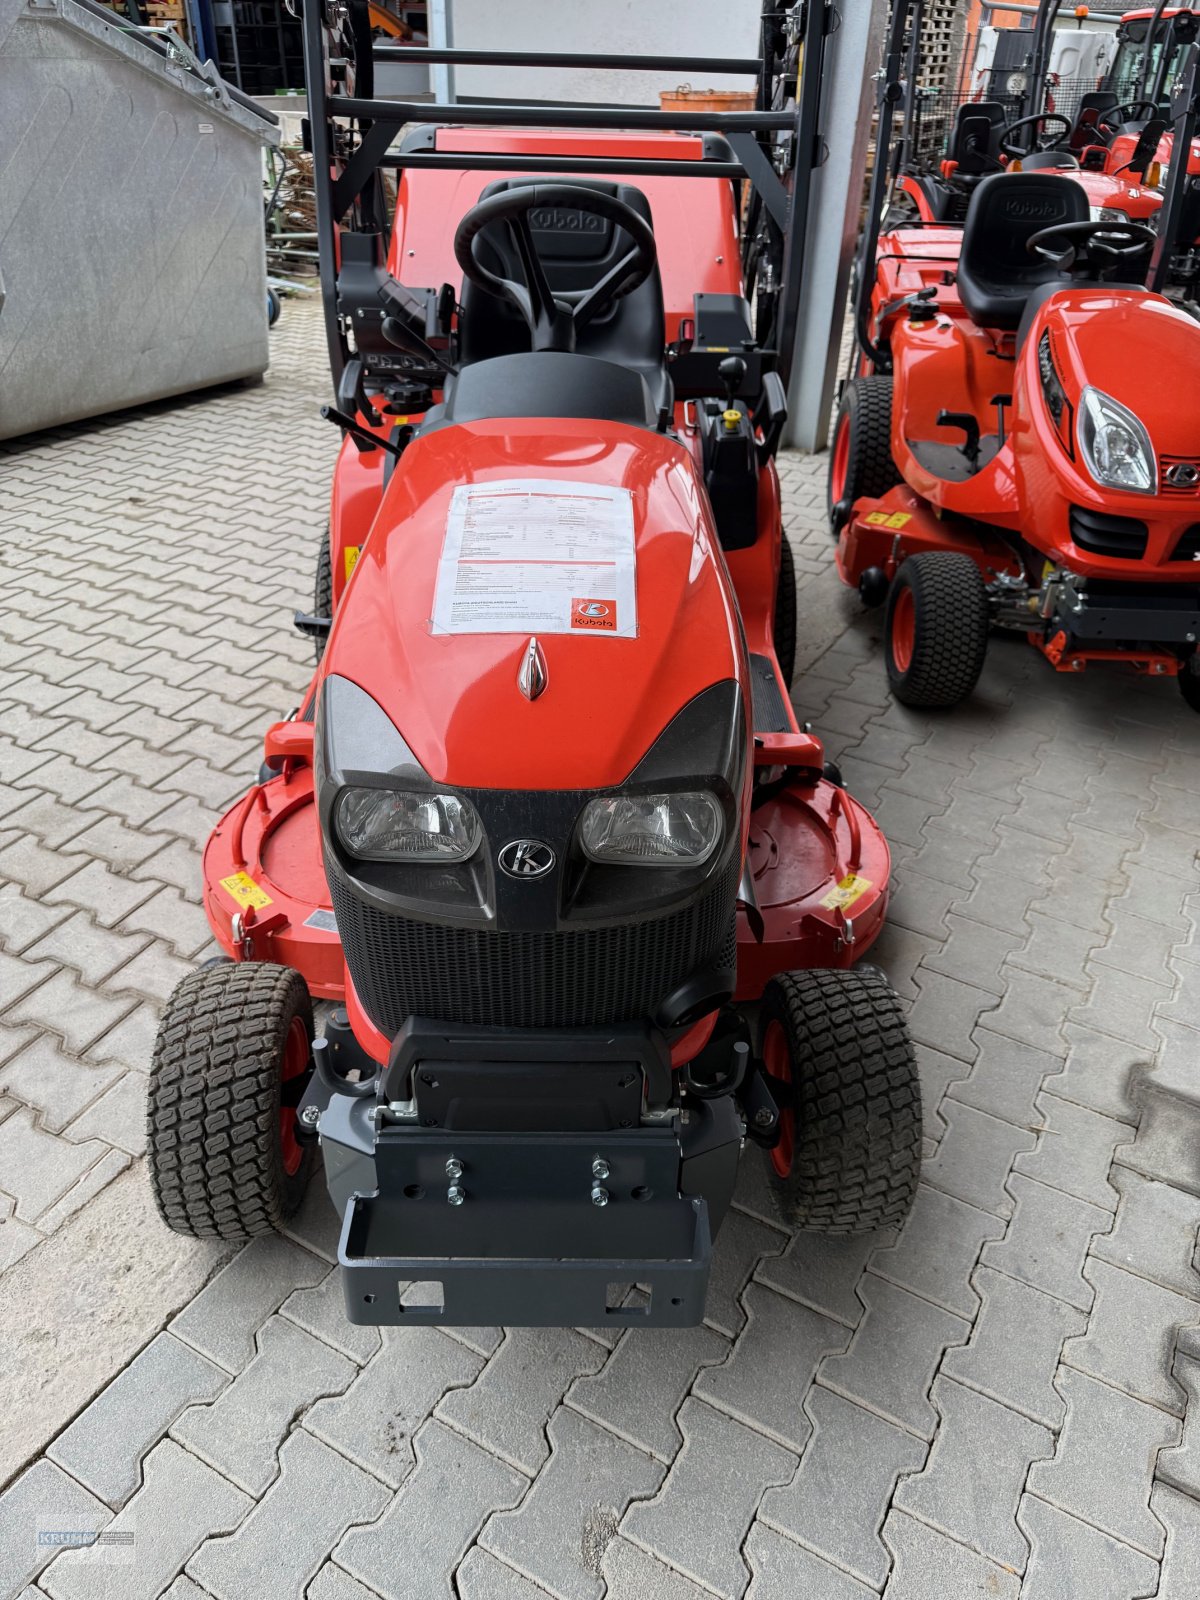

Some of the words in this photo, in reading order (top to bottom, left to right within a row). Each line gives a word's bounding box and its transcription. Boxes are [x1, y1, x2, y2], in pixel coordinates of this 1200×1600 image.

[1006, 201, 1057, 216] Kubota
[528, 208, 598, 229] Kubota
[574, 617, 613, 627] Kubota
